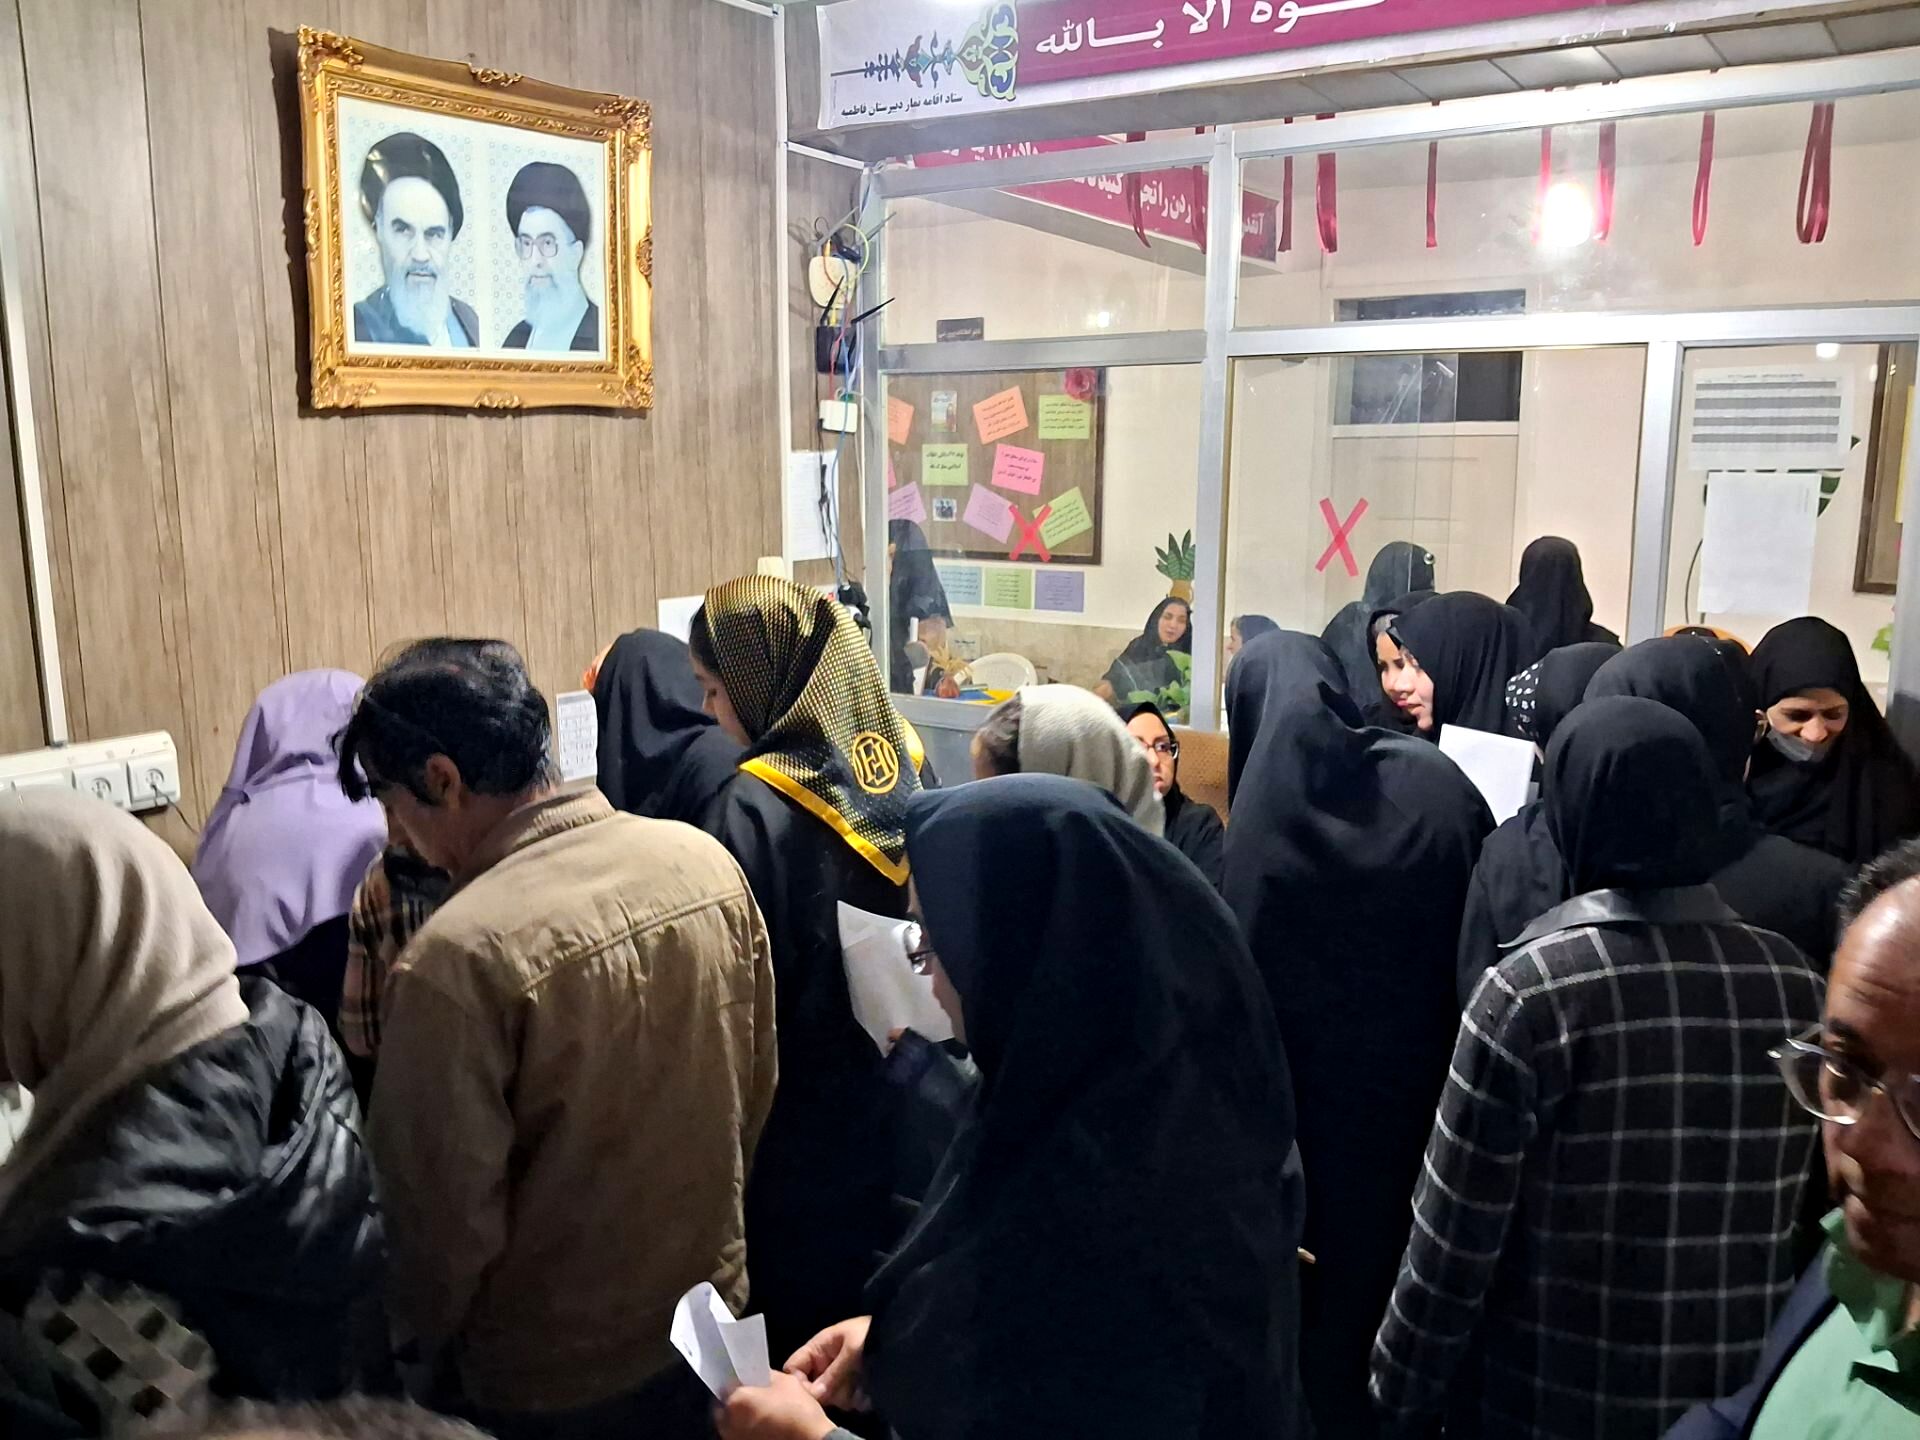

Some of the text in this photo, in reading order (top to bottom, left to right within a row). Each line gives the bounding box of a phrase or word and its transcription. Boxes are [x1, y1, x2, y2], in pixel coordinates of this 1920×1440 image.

[1036, 17, 1165, 54] بالله
[923, 93, 943, 106] اقامه
[945, 92, 963, 104] ستاد
[841, 104, 867, 118] فاطمیه
[868, 101, 904, 116] دبیرستان
